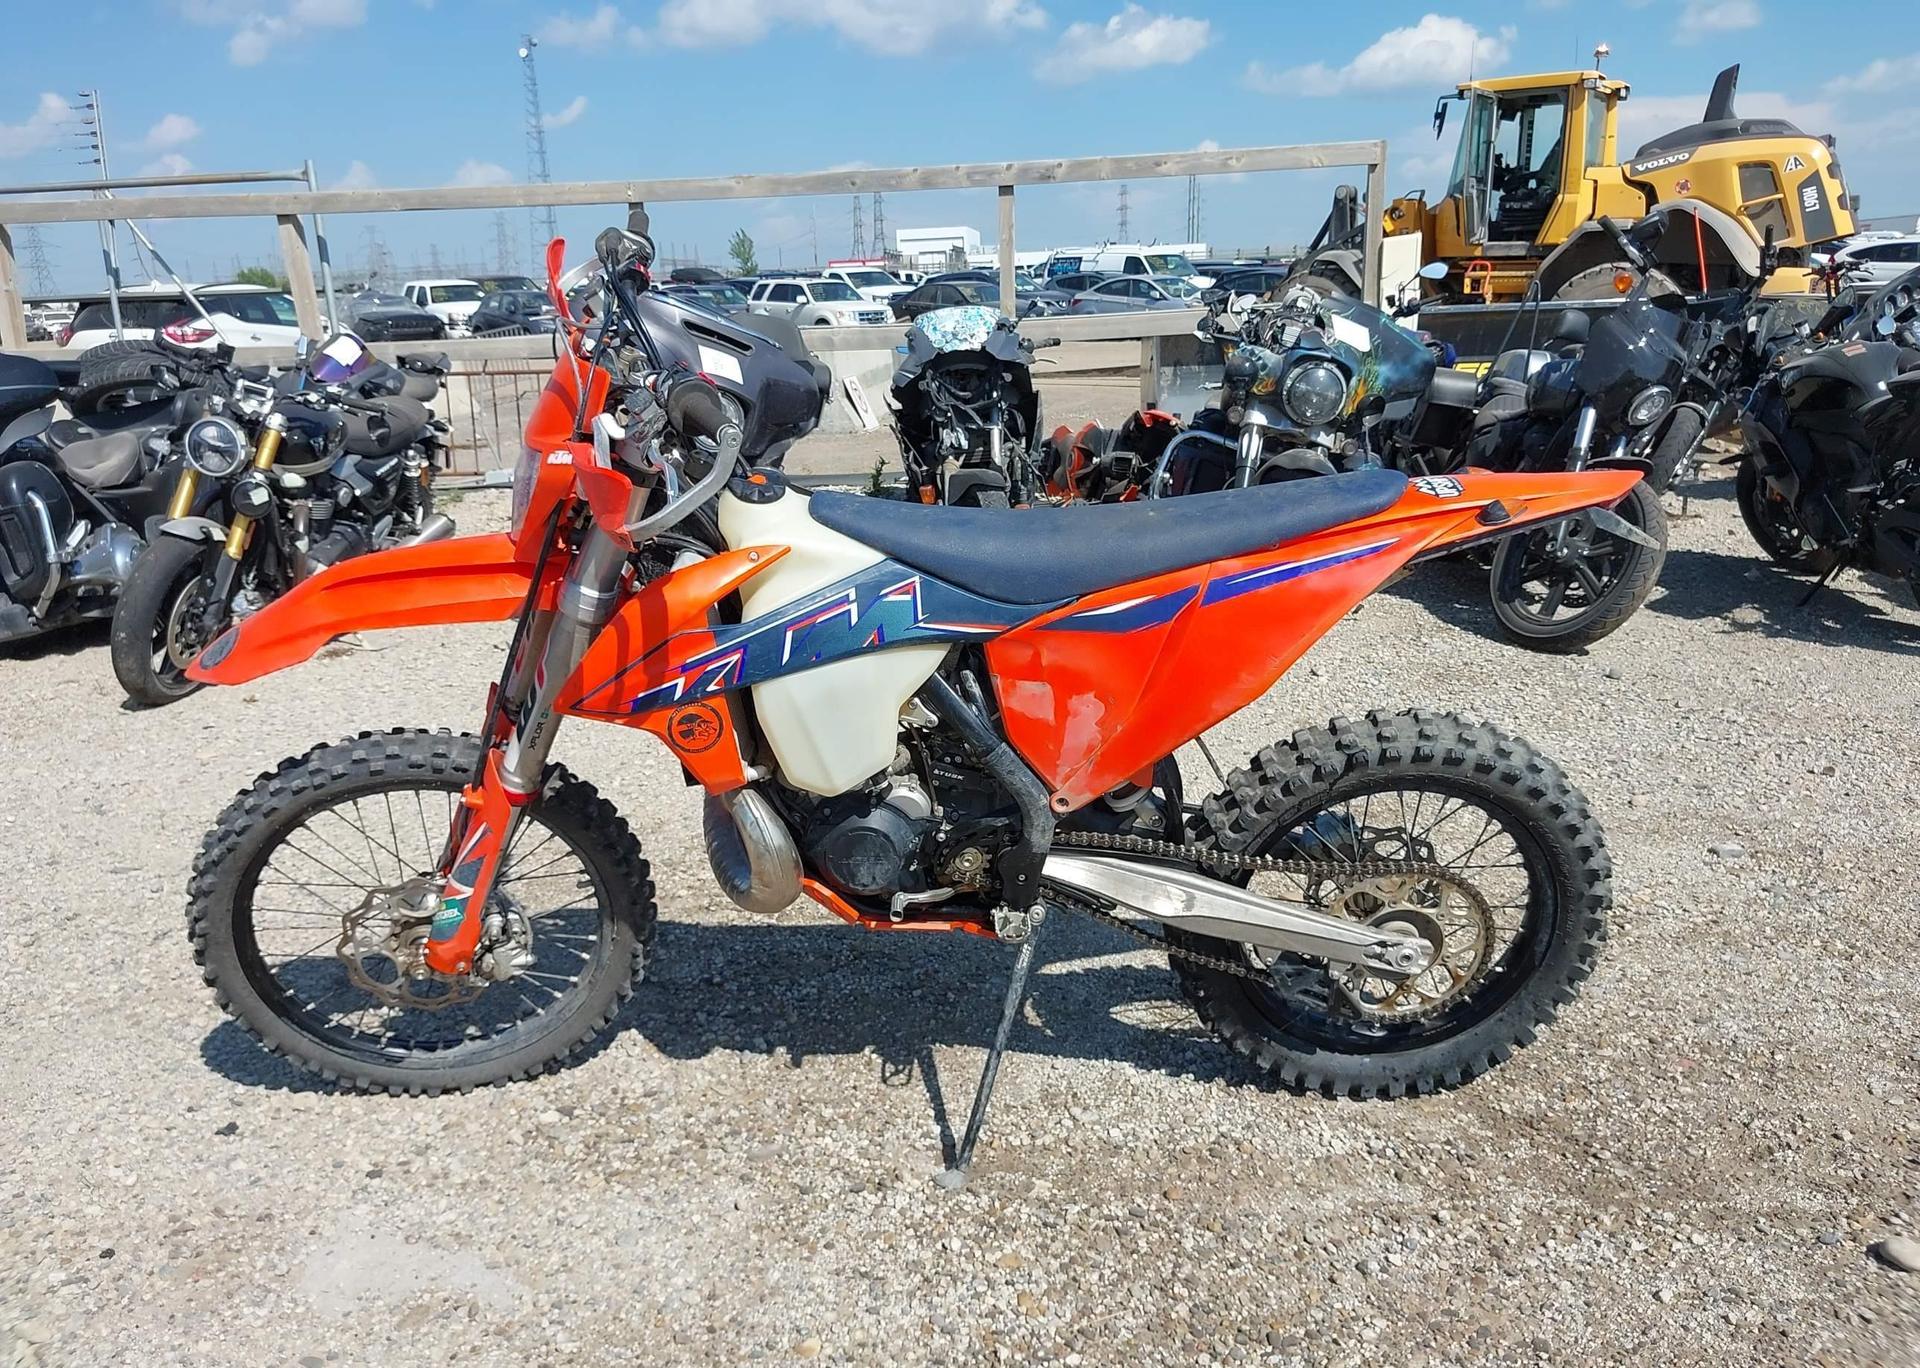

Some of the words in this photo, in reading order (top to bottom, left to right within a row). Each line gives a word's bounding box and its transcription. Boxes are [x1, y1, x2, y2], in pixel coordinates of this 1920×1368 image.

[1635, 152, 1690, 171] VOLVO
[1802, 185, 1820, 212] L90H
[547, 450, 573, 465] KTM
